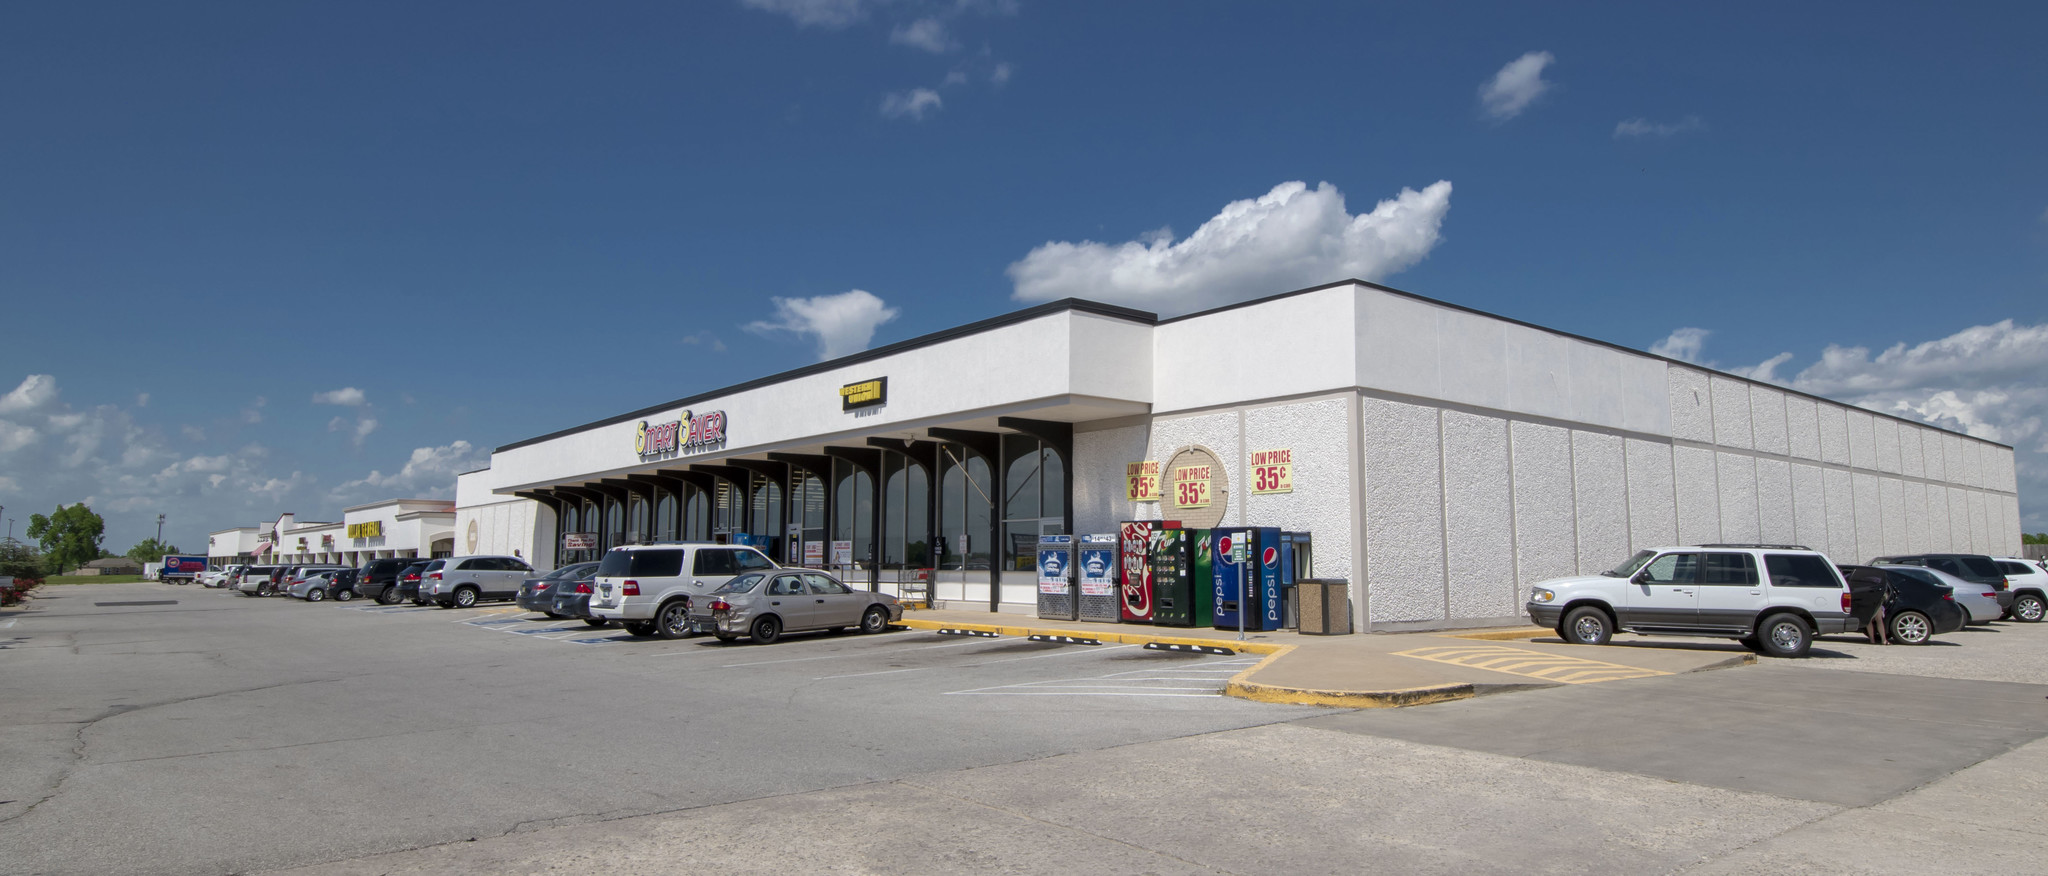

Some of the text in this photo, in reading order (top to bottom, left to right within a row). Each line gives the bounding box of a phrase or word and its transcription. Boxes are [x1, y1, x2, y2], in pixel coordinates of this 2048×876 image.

[1127, 462, 1159, 475] LOW PRICE
[1251, 449, 1291, 466] LOW PRICE
[1174, 466, 1210, 481] LOW PRICE
[1255, 466, 1286, 491] 35¢
[1130, 476, 1155, 498] 35¢
[1178, 482, 1205, 505] 35¢
[1197, 534, 1212, 558] 7U
[1214, 574, 1225, 617] pepsi
[1265, 572, 1278, 621] pepsi
